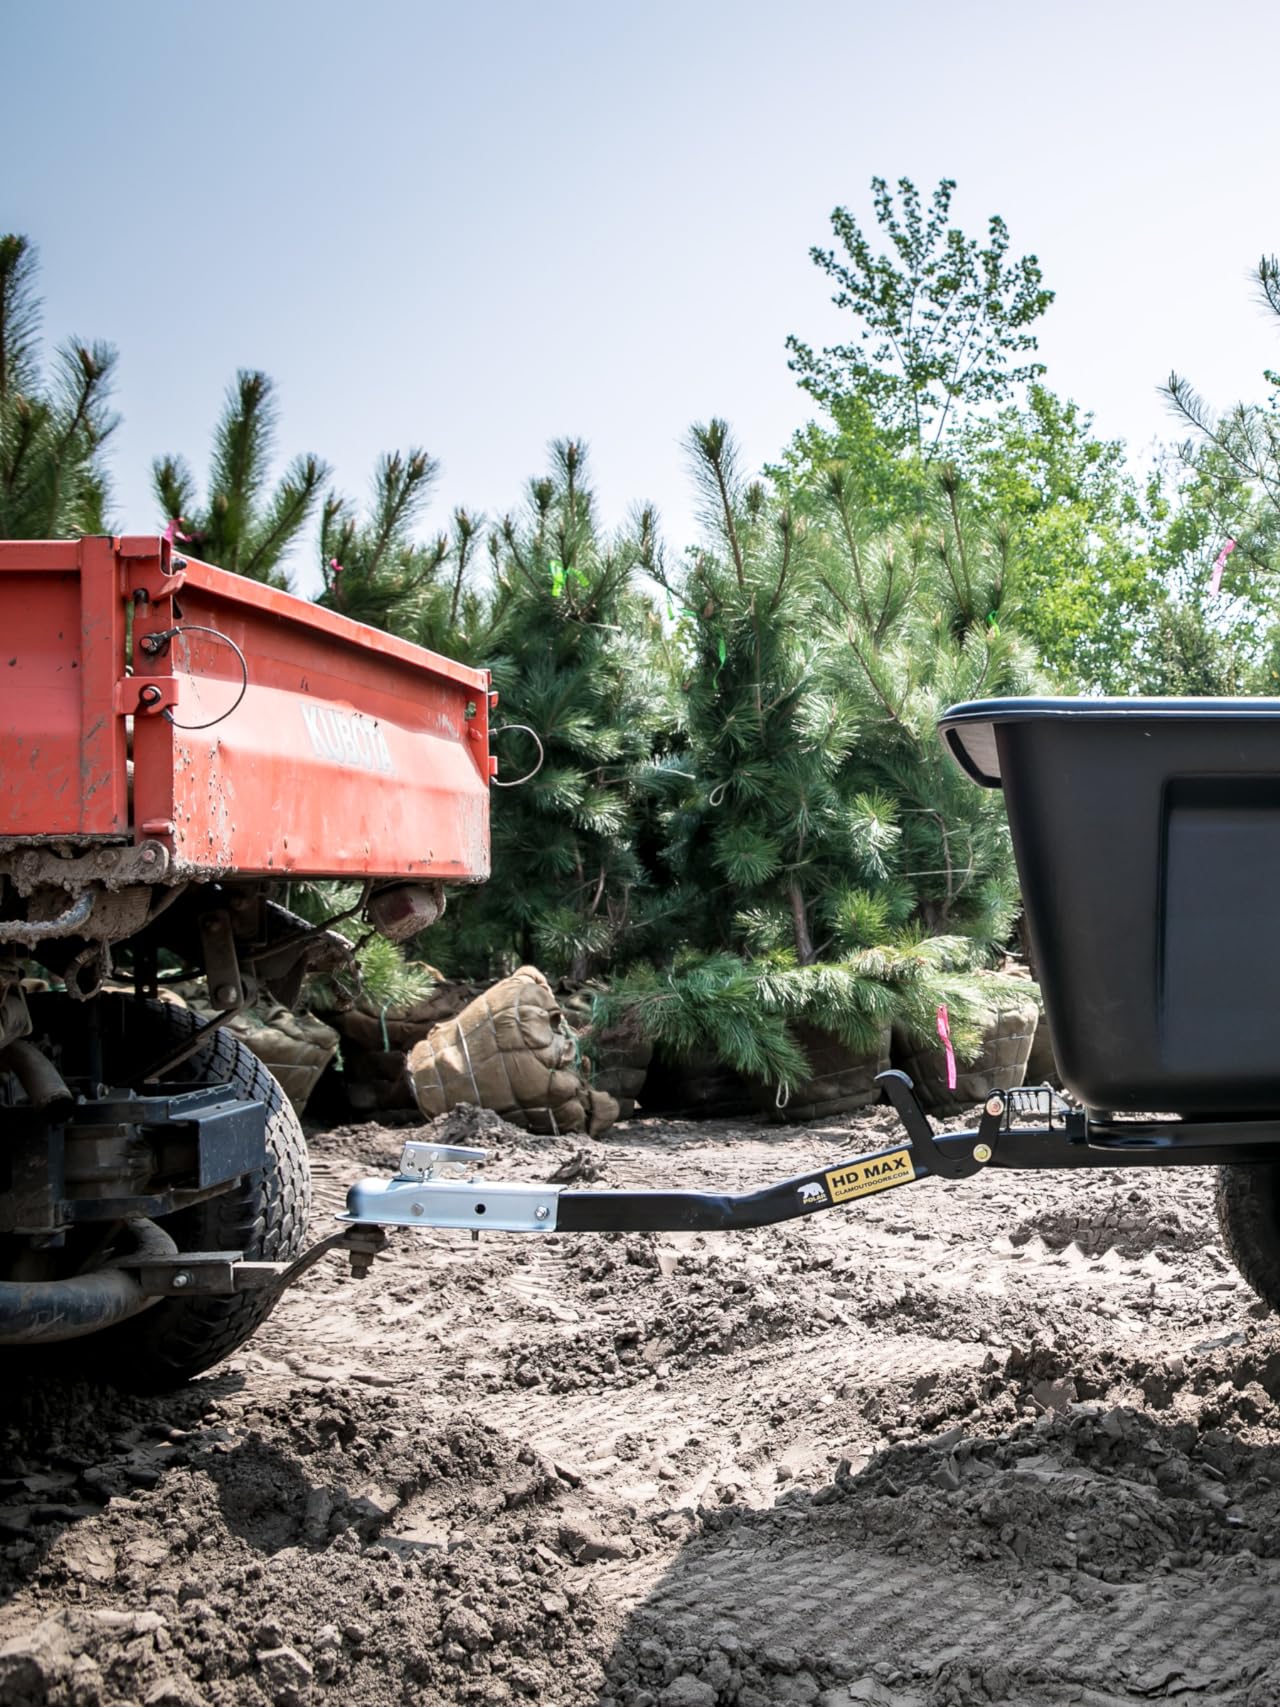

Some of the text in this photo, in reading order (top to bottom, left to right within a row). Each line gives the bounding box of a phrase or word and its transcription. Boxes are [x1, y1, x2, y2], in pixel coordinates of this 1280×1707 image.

[298, 702, 395, 775] KUBOTA
[831, 1156, 907, 1189] HD MAX
[834, 1170, 909, 1197] CLAMOUTDOORS.COM
